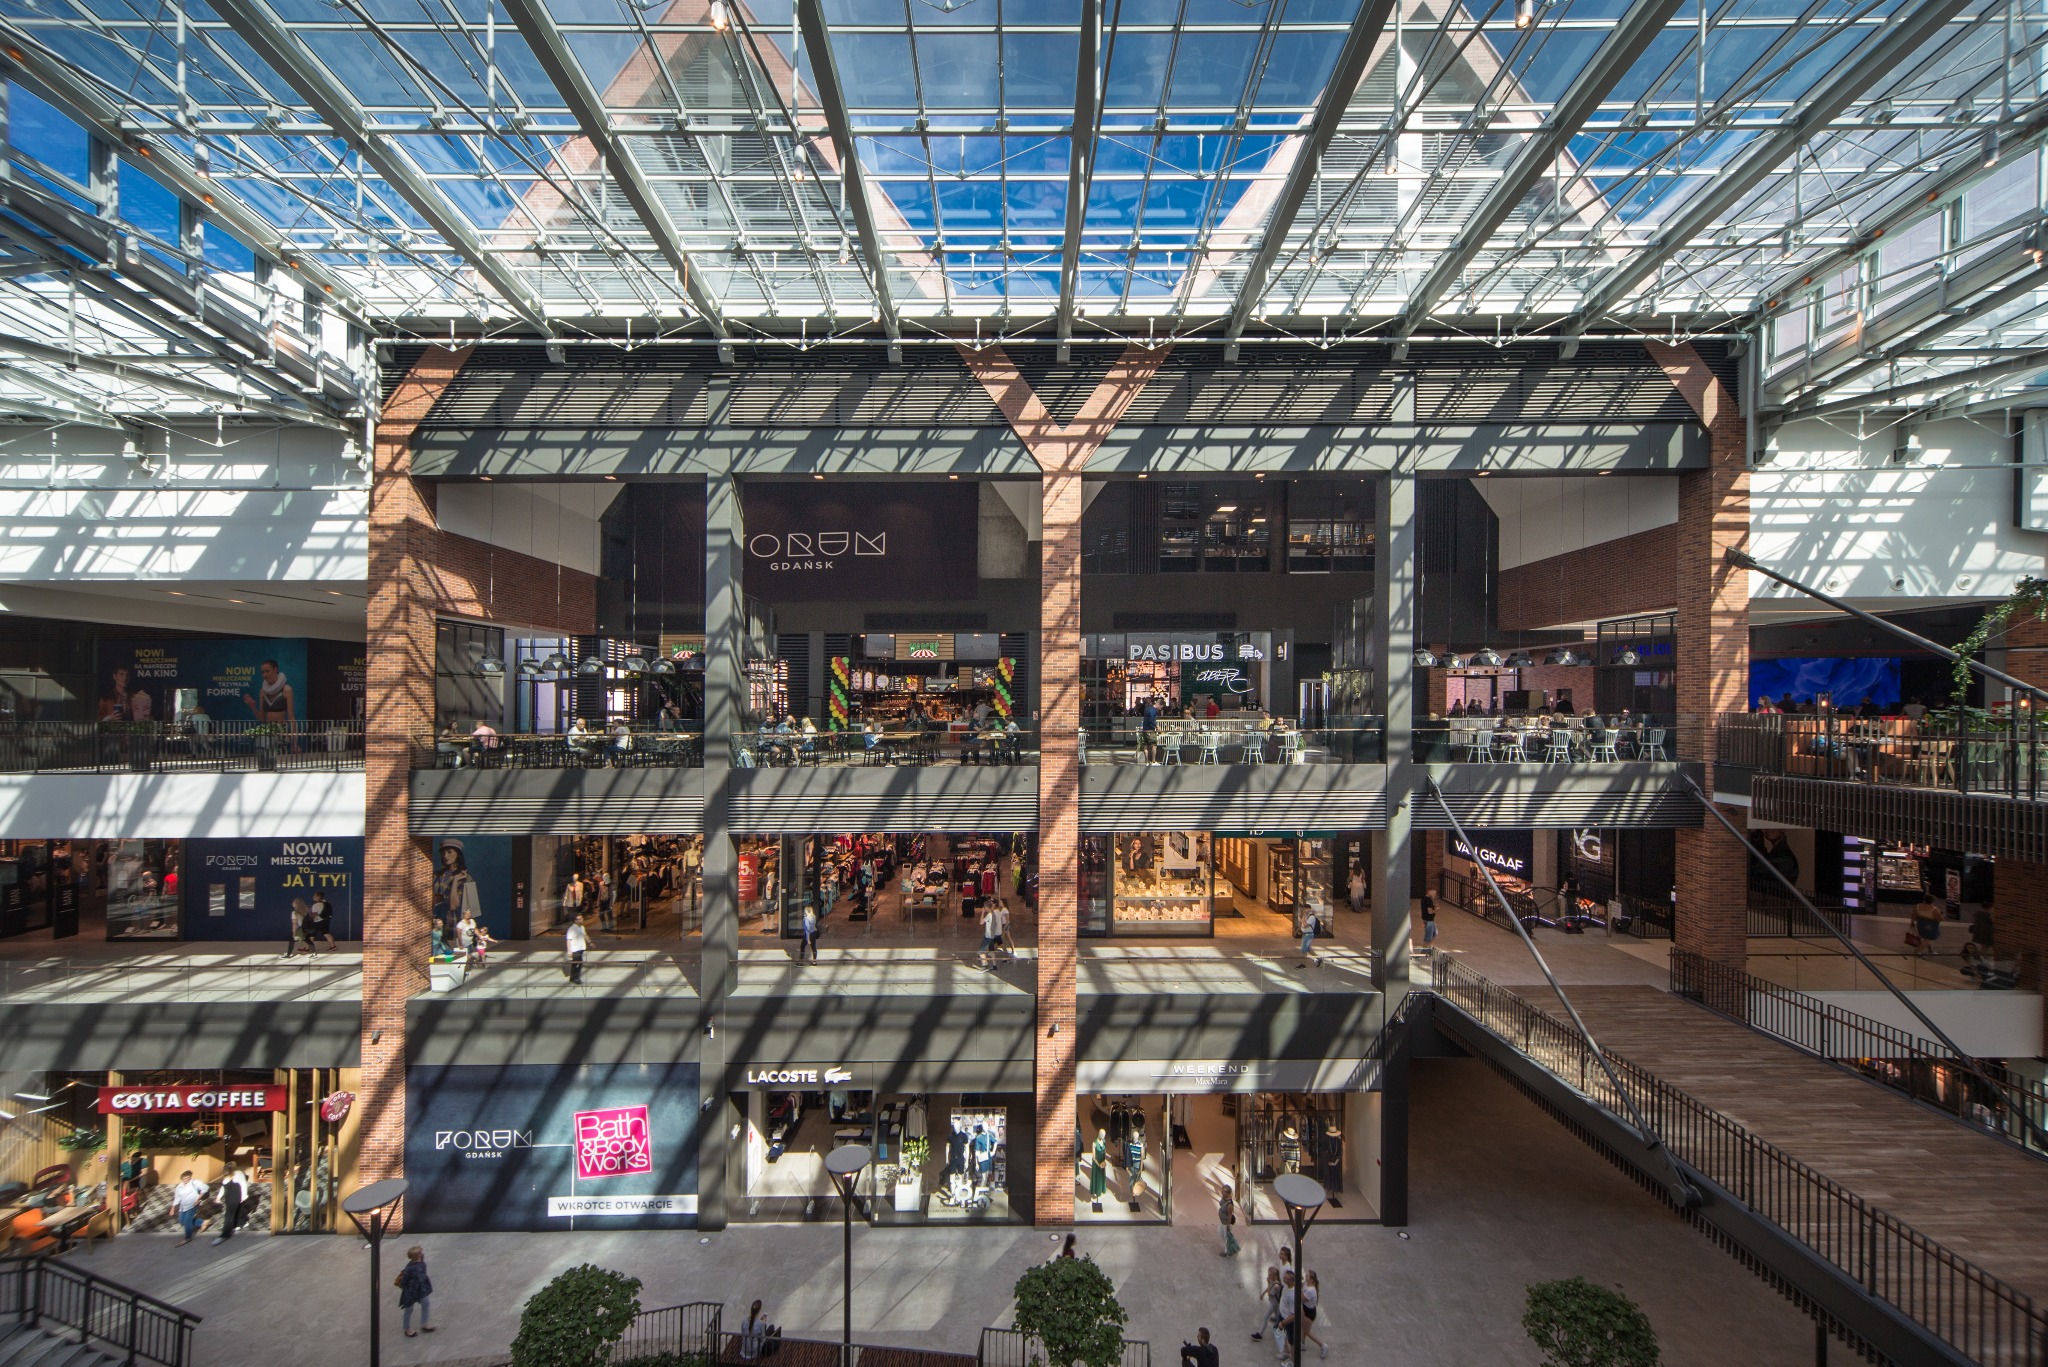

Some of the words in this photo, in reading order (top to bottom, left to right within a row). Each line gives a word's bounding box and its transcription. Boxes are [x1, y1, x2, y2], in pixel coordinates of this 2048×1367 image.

[743, 531, 886, 558] ORUM
[770, 559, 834, 571] GDAŃSK
[135, 649, 165, 658] NOWI
[1129, 644, 1224, 660] PASIBUS
[137, 669, 152, 678] NA
[154, 669, 178, 678] KINO
[226, 666, 256, 676] NOWI
[207, 688, 241, 698] FORMĘ
[283, 842, 332, 856] NOWI
[206, 855, 258, 866] FORUM
[271, 856, 344, 866] MIESZCZANIE
[1480, 848, 1524, 871] GRAAF
[298, 866, 317, 874] TO...
[282, 874, 304, 888] JA
[309, 874, 315, 887] I
[319, 873, 347, 887] TY!
[1173, 1065, 1250, 1074] WEEKEND
[747, 1069, 818, 1084] LACOSTE
[111, 1092, 182, 1111] COSTA
[186, 1090, 267, 1108] COFFEE
[577, 1112, 646, 1143] Bath
[435, 1129, 532, 1150] FORUM
[465, 1150, 503, 1159] GDAŃSK
[580, 1152, 649, 1173] Works
[557, 1199, 612, 1211] WKRÓTCE
[615, 1199, 673, 1210] OTWARCIE
